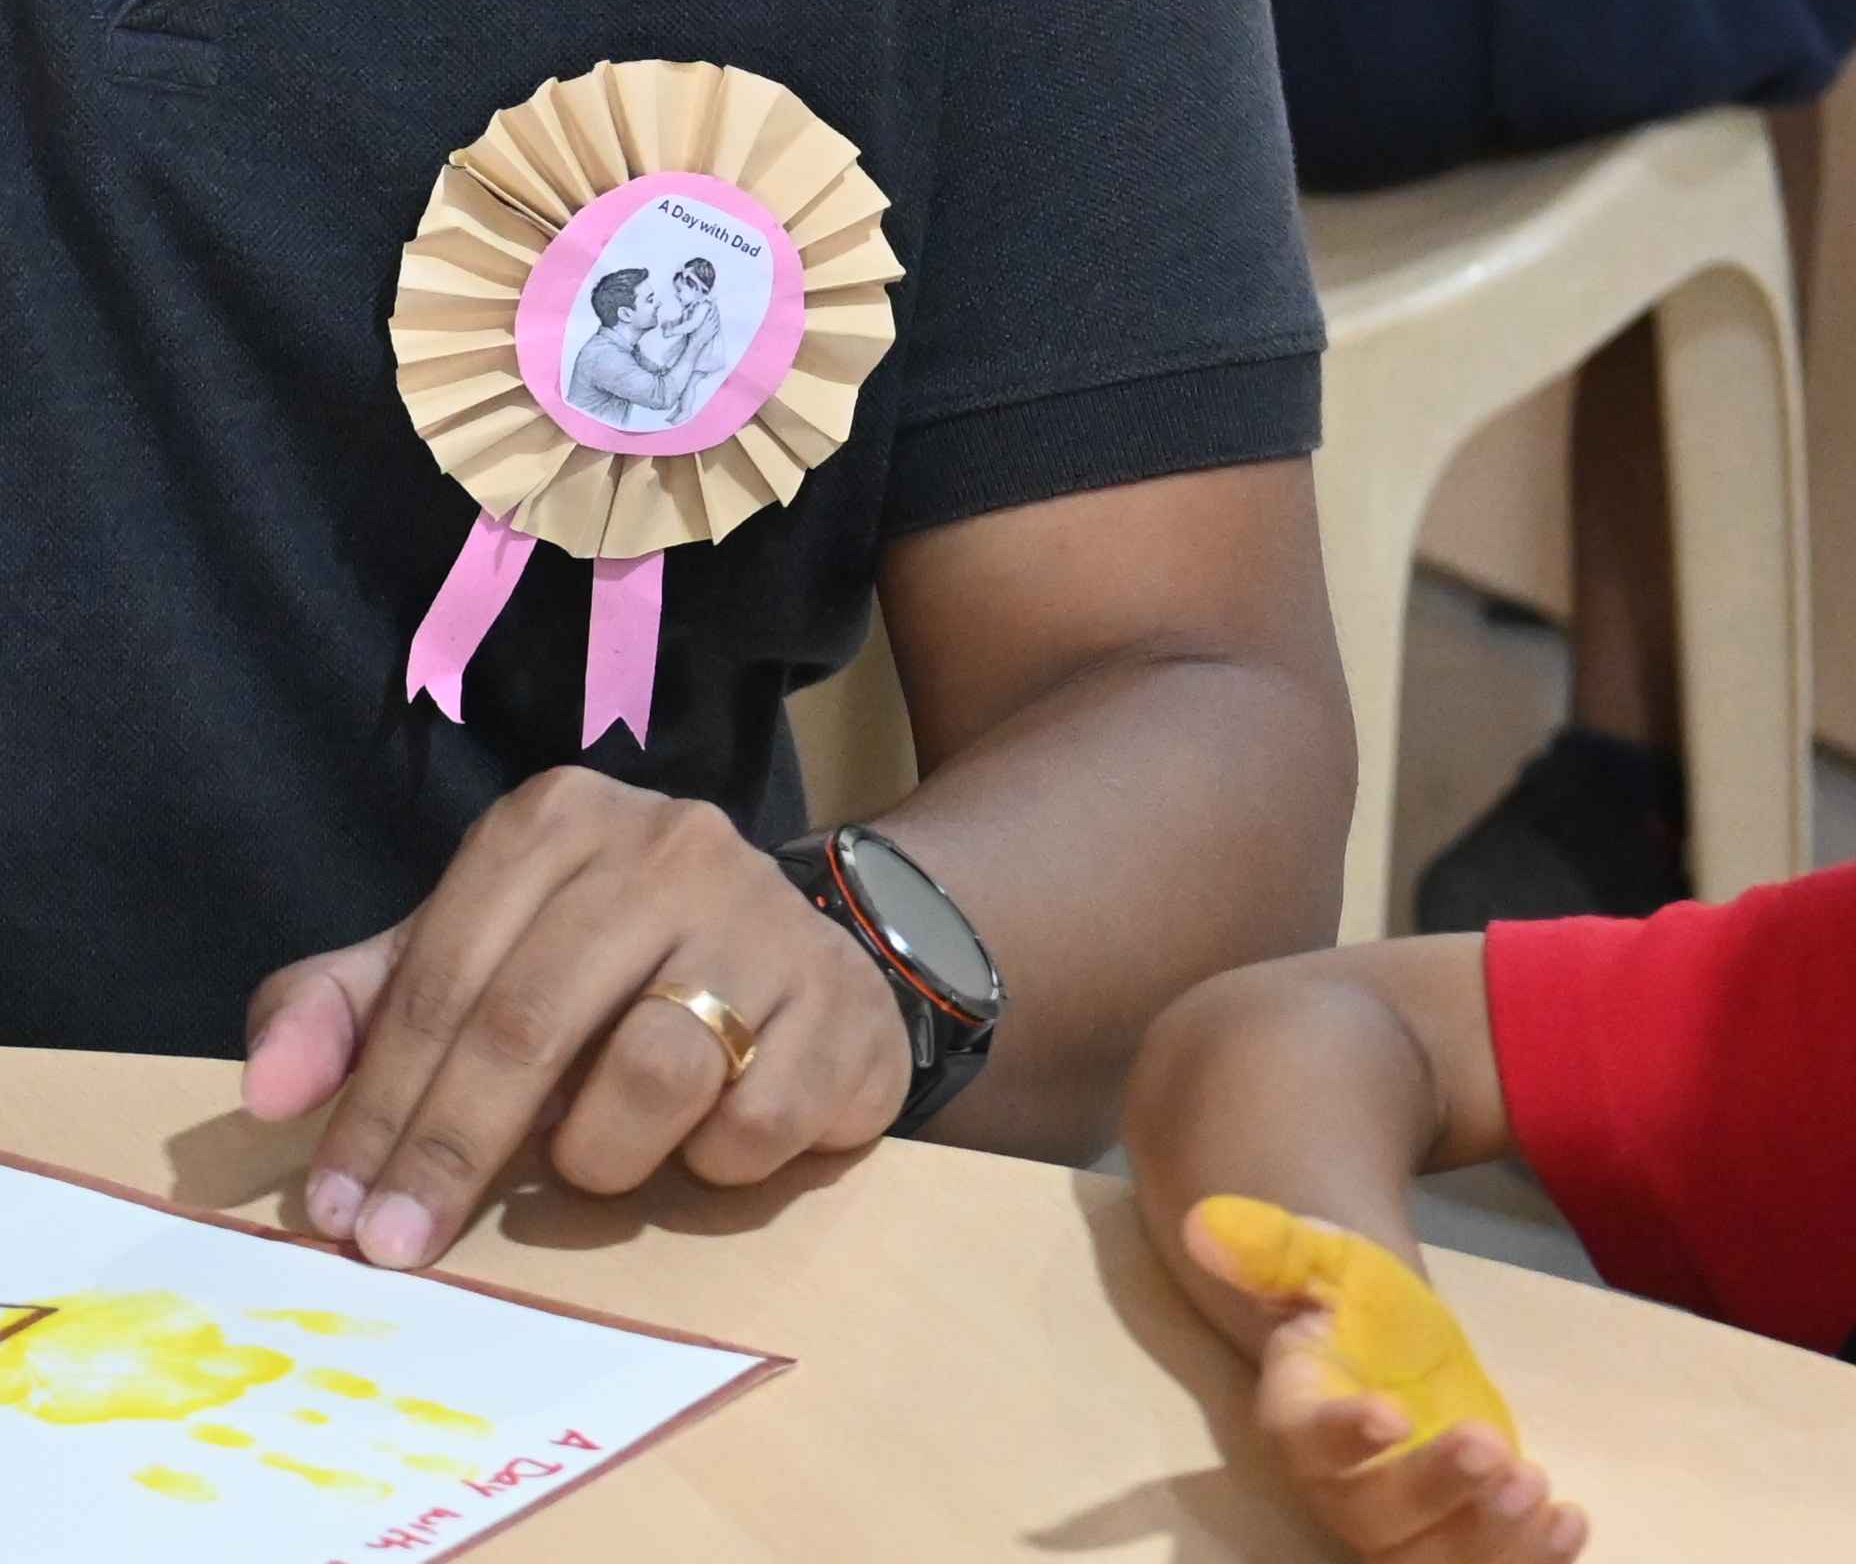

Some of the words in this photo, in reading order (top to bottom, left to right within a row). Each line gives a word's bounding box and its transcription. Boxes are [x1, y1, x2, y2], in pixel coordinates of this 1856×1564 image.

[657, 199, 670, 214] A
[671, 204, 700, 229] Day
[699, 219, 729, 244] with
[731, 234, 762, 258] Dad
[548, 1428, 604, 1451] A
[459, 1456, 565, 1499] Day
[364, 1506, 464, 1551] with
